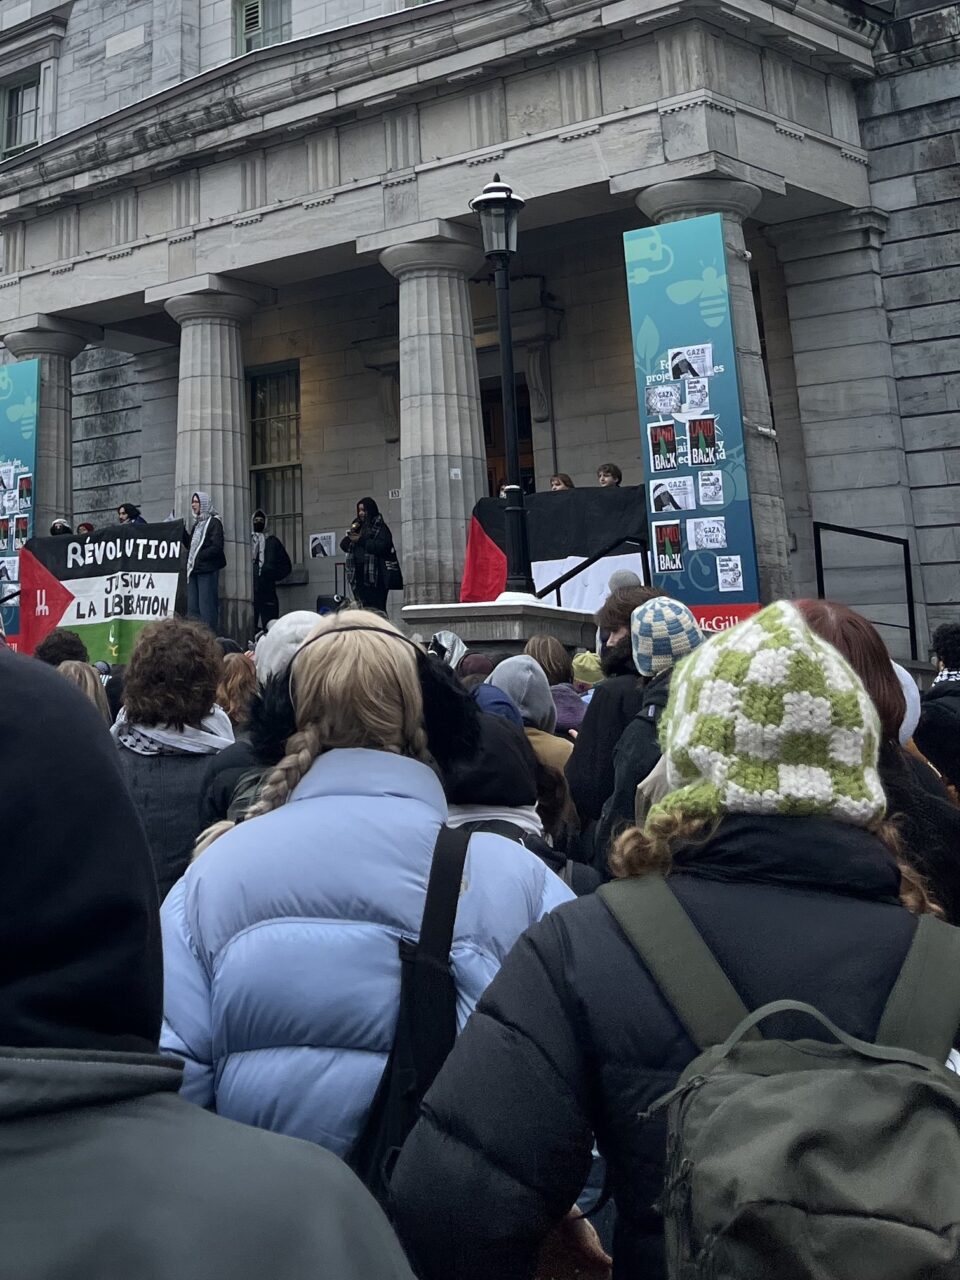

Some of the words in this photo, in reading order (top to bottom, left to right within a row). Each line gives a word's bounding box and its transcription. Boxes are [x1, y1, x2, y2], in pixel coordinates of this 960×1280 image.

[686, 348, 705, 356] GAZA
[654, 452, 677, 469] BACK
[692, 447, 715, 463] BACK
[668, 480, 687, 488] GAZA
[67, 537, 181, 568] RÉVOLUTION
[660, 553, 682, 570] BACK
[76, 601, 97, 619] LA
